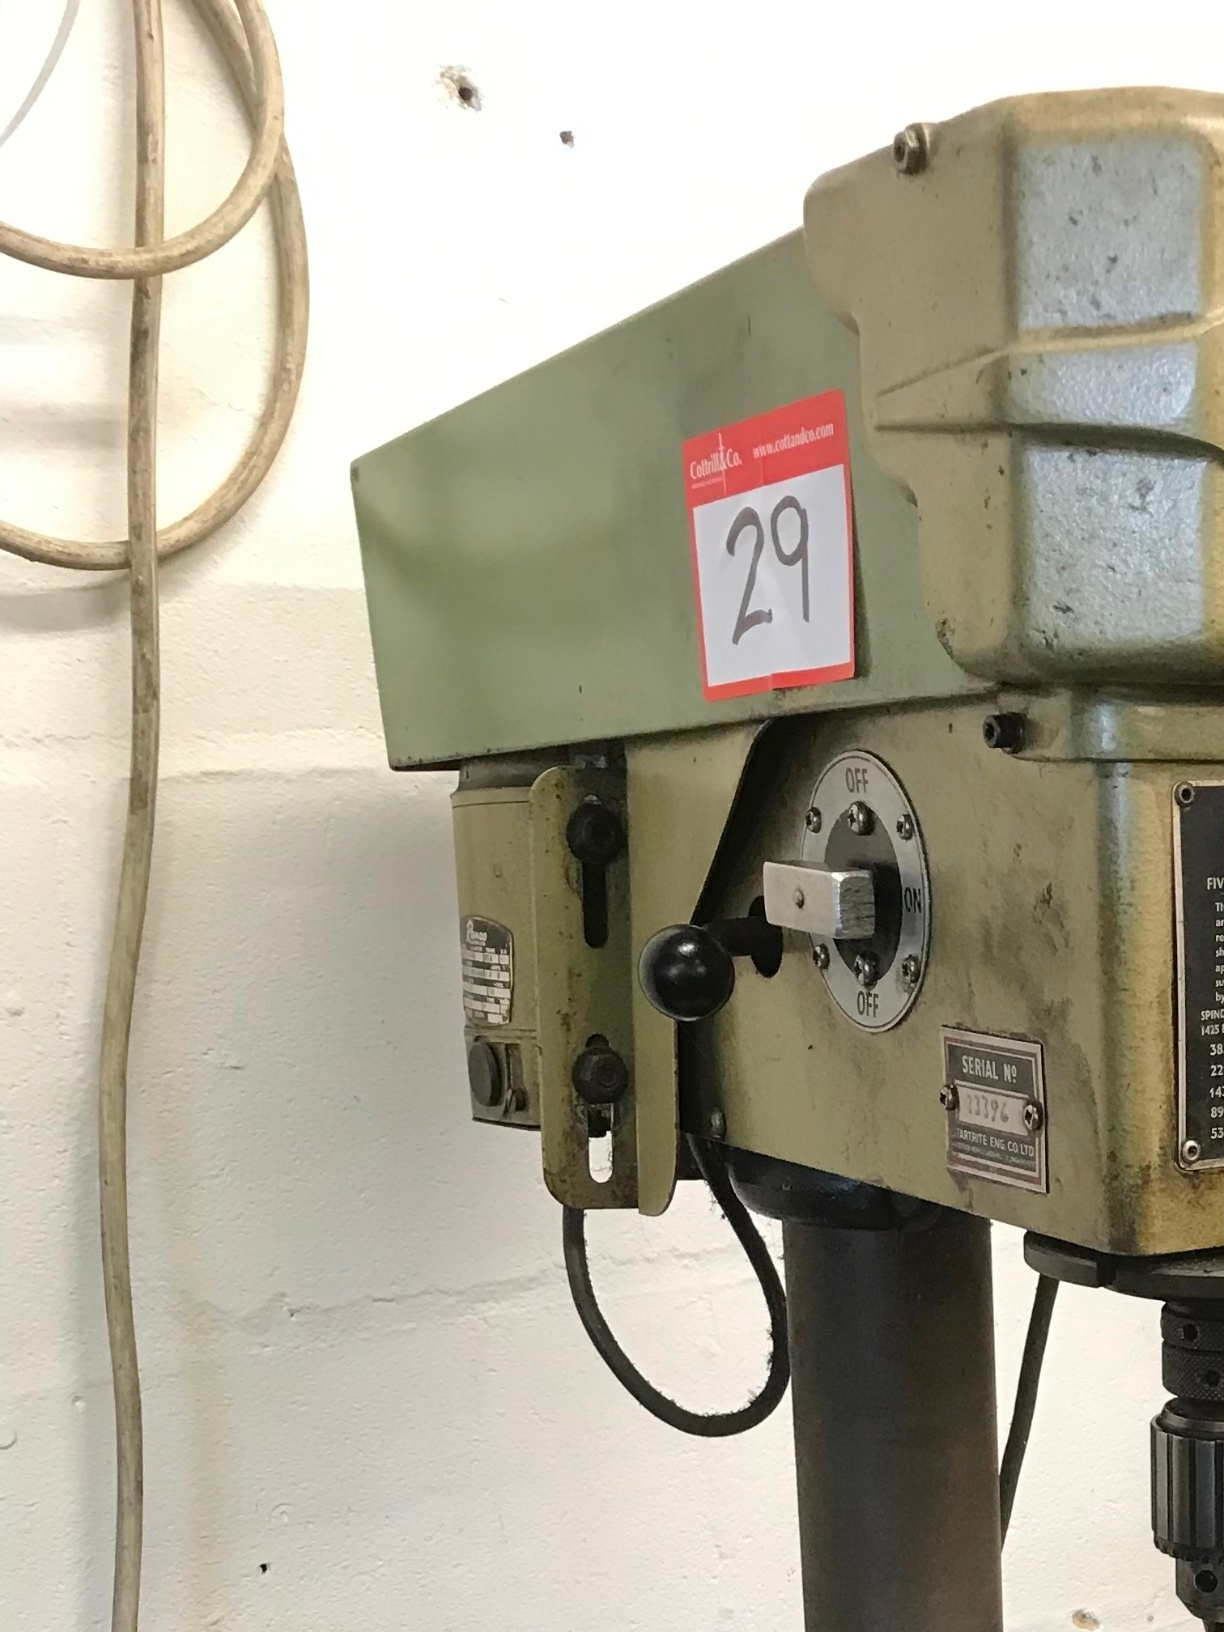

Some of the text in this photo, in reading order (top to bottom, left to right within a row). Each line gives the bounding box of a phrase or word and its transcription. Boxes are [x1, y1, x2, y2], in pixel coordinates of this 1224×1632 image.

[752, 422, 834, 459] www.cottandco.com
[726, 495, 810, 646] 29
[845, 768, 870, 794] OFF
[904, 888, 922, 914] ON
[857, 990, 879, 1018] OFF
[962, 1055, 998, 1081] SERIAL
[1020, 1143, 1035, 1157] LTD
